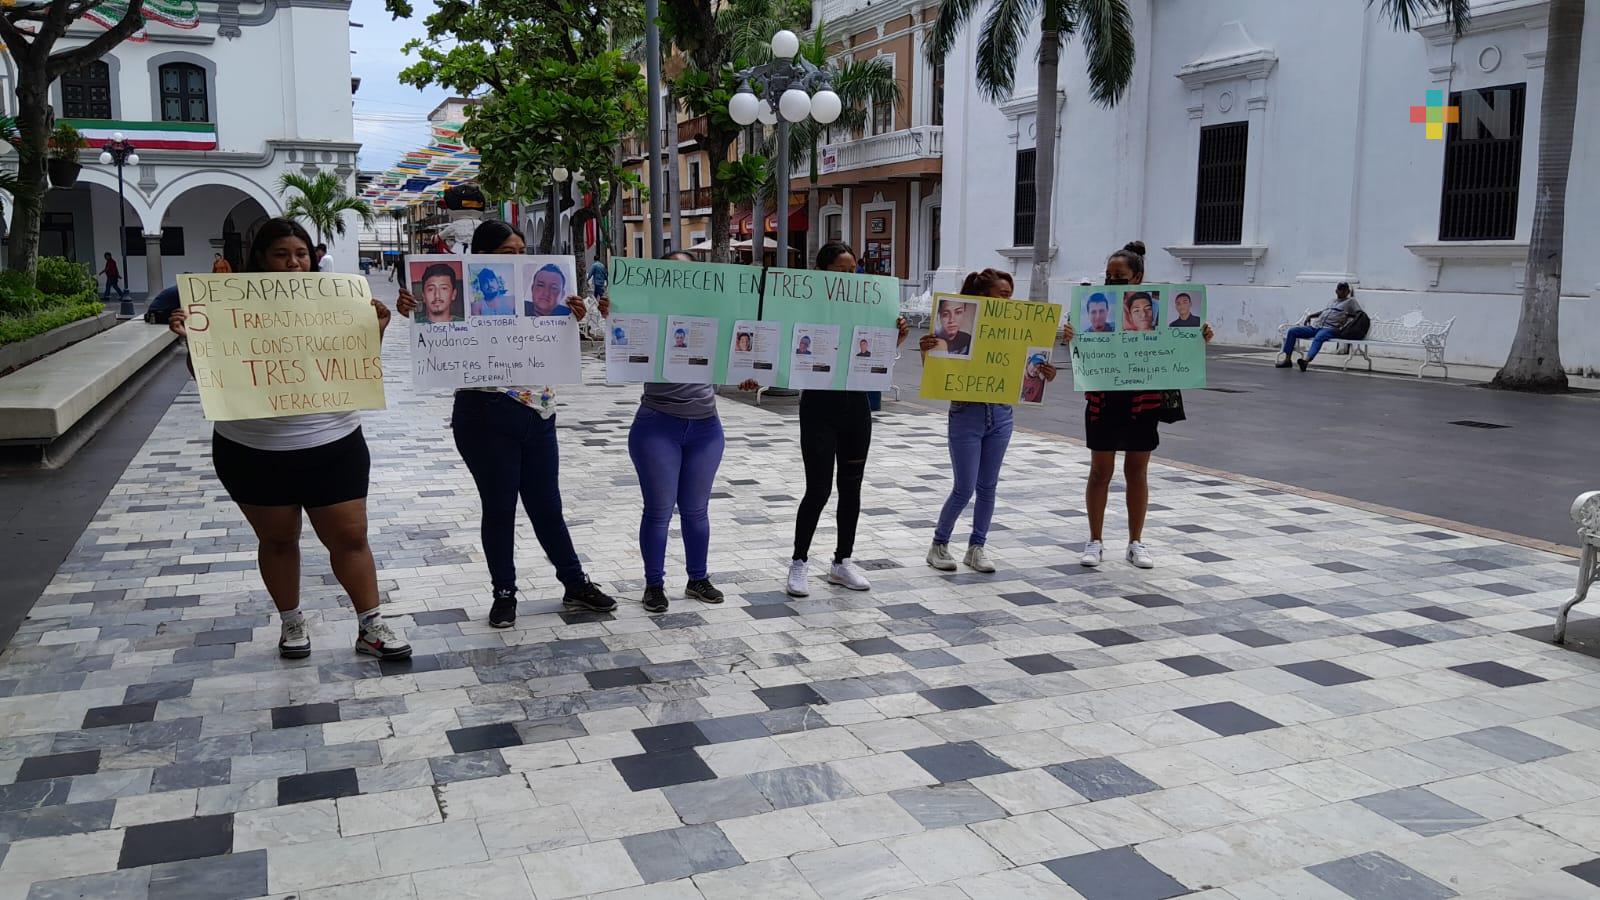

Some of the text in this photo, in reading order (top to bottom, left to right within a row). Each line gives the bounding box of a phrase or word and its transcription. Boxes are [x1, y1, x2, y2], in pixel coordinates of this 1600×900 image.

[188, 276, 366, 304] DESAPARECEN
[612, 258, 882, 305] DESAPARECEN EN TRES VALLES
[188, 303, 354, 332] 5 TRABAJADORES
[983, 300, 1056, 324] NUESTRA
[418, 332, 479, 353] Ayudanos
[490, 336, 498, 344] a
[978, 324, 1033, 342] FAMILIA
[196, 334, 369, 358] DE LA CONSTRUCCION
[1072, 346, 1116, 362] Ayudanos
[1134, 348, 1176, 362] regresar
[488, 356, 524, 369] FAMILIAS
[986, 351, 1010, 367] NOS
[1128, 362, 1168, 374] FAMILIAS
[200, 356, 383, 389] EN TRES VALLES
[944, 374, 1005, 392] ESPERA
[268, 392, 353, 412] VERACRUZ
